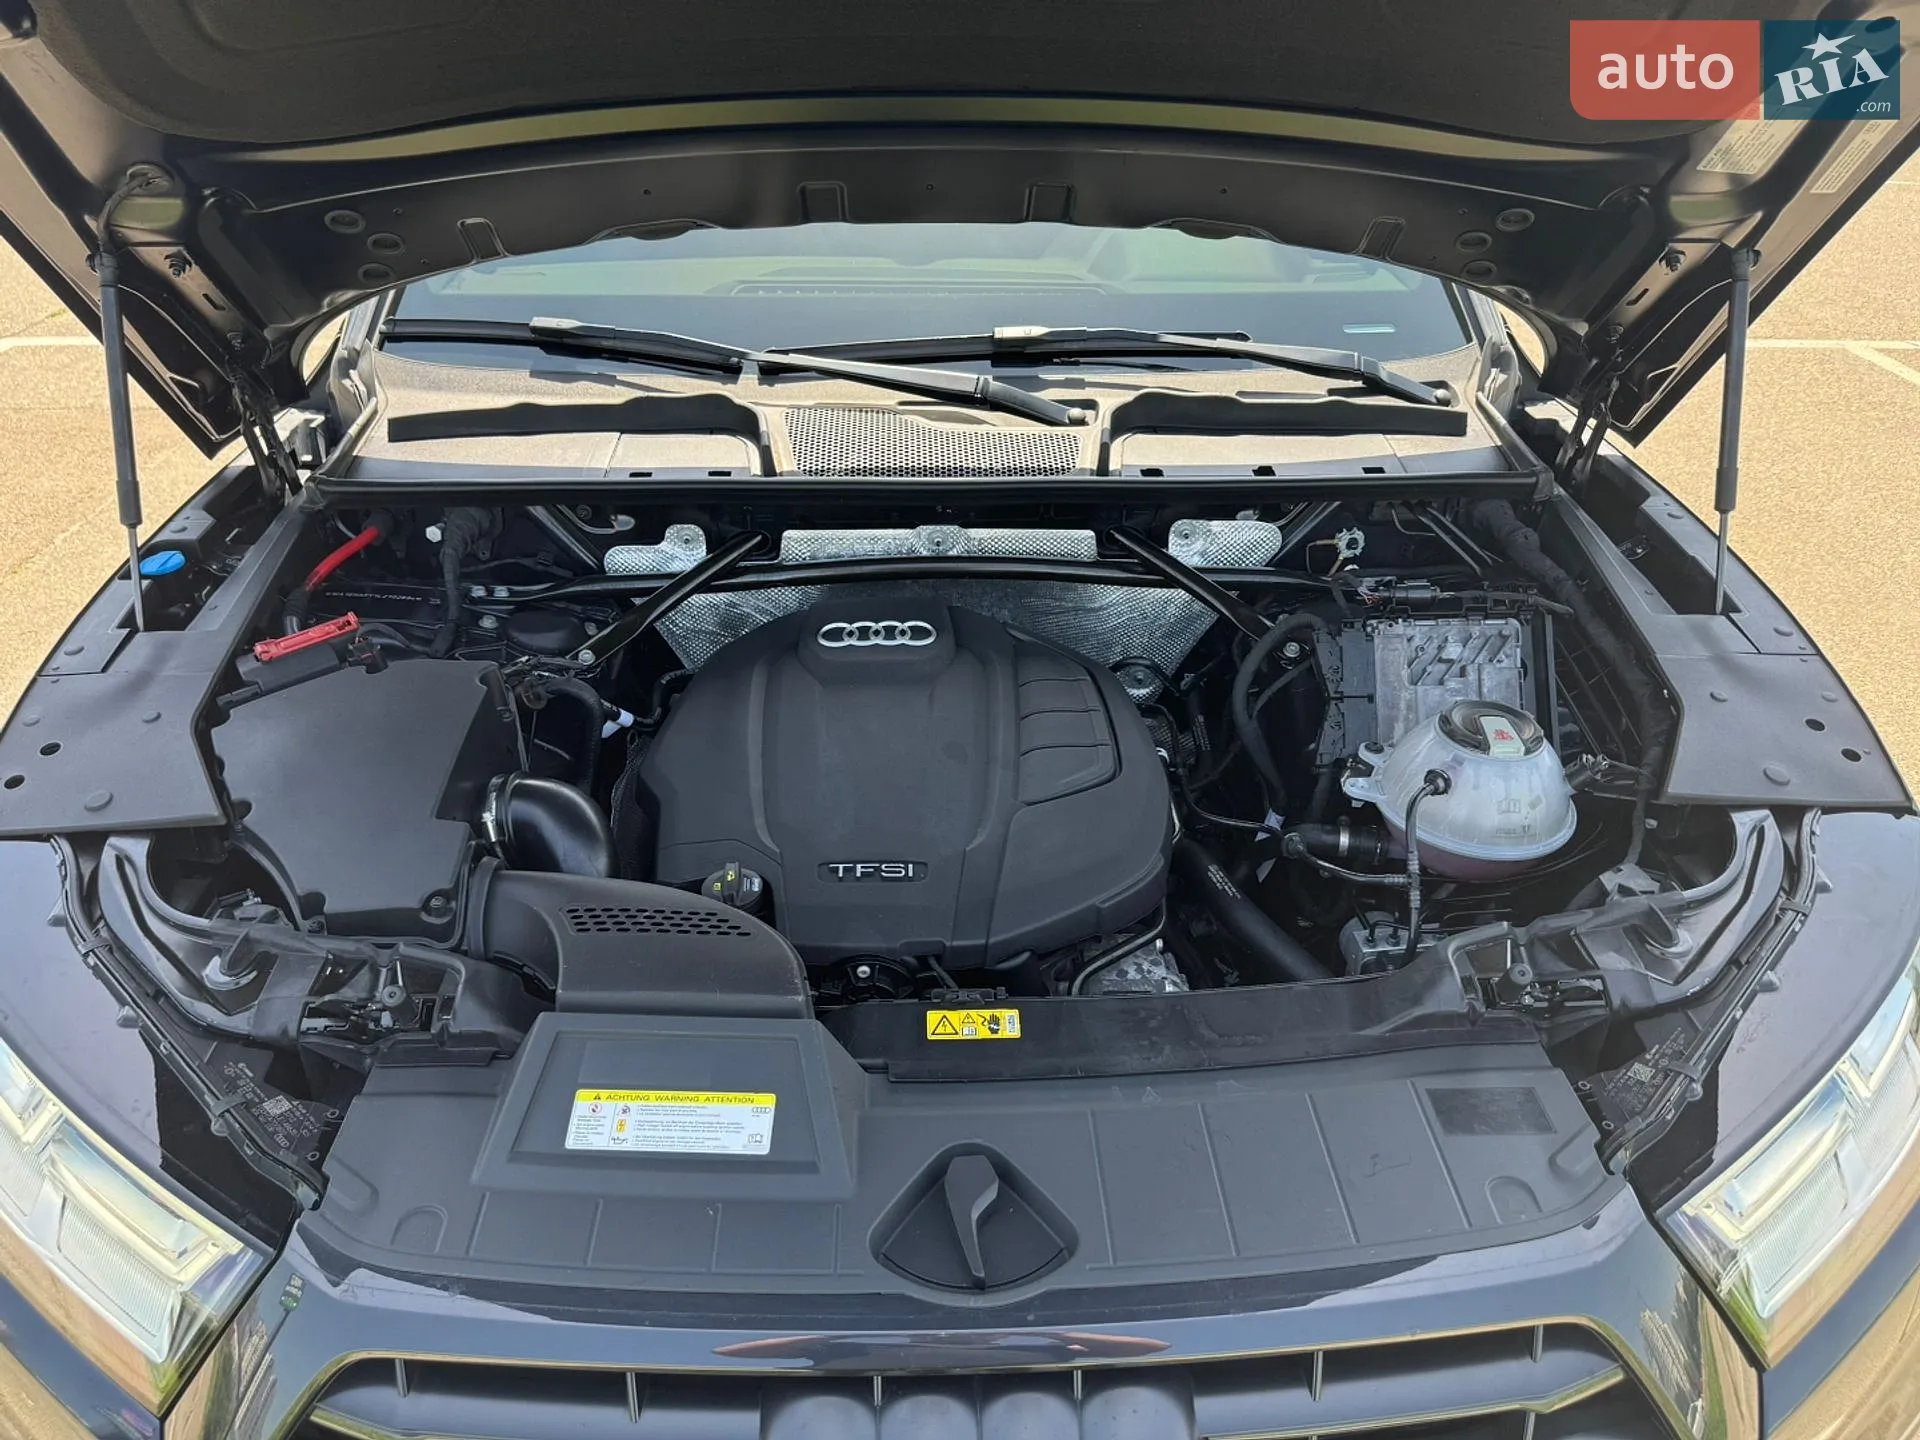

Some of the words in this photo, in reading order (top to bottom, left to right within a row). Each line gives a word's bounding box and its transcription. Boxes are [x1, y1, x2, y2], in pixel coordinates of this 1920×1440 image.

[828, 863, 914, 878] TFSI
[606, 1093, 650, 1101] ACHTUNG
[655, 1095, 699, 1103] WARNING
[704, 1096, 755, 1104] ATTENTION
